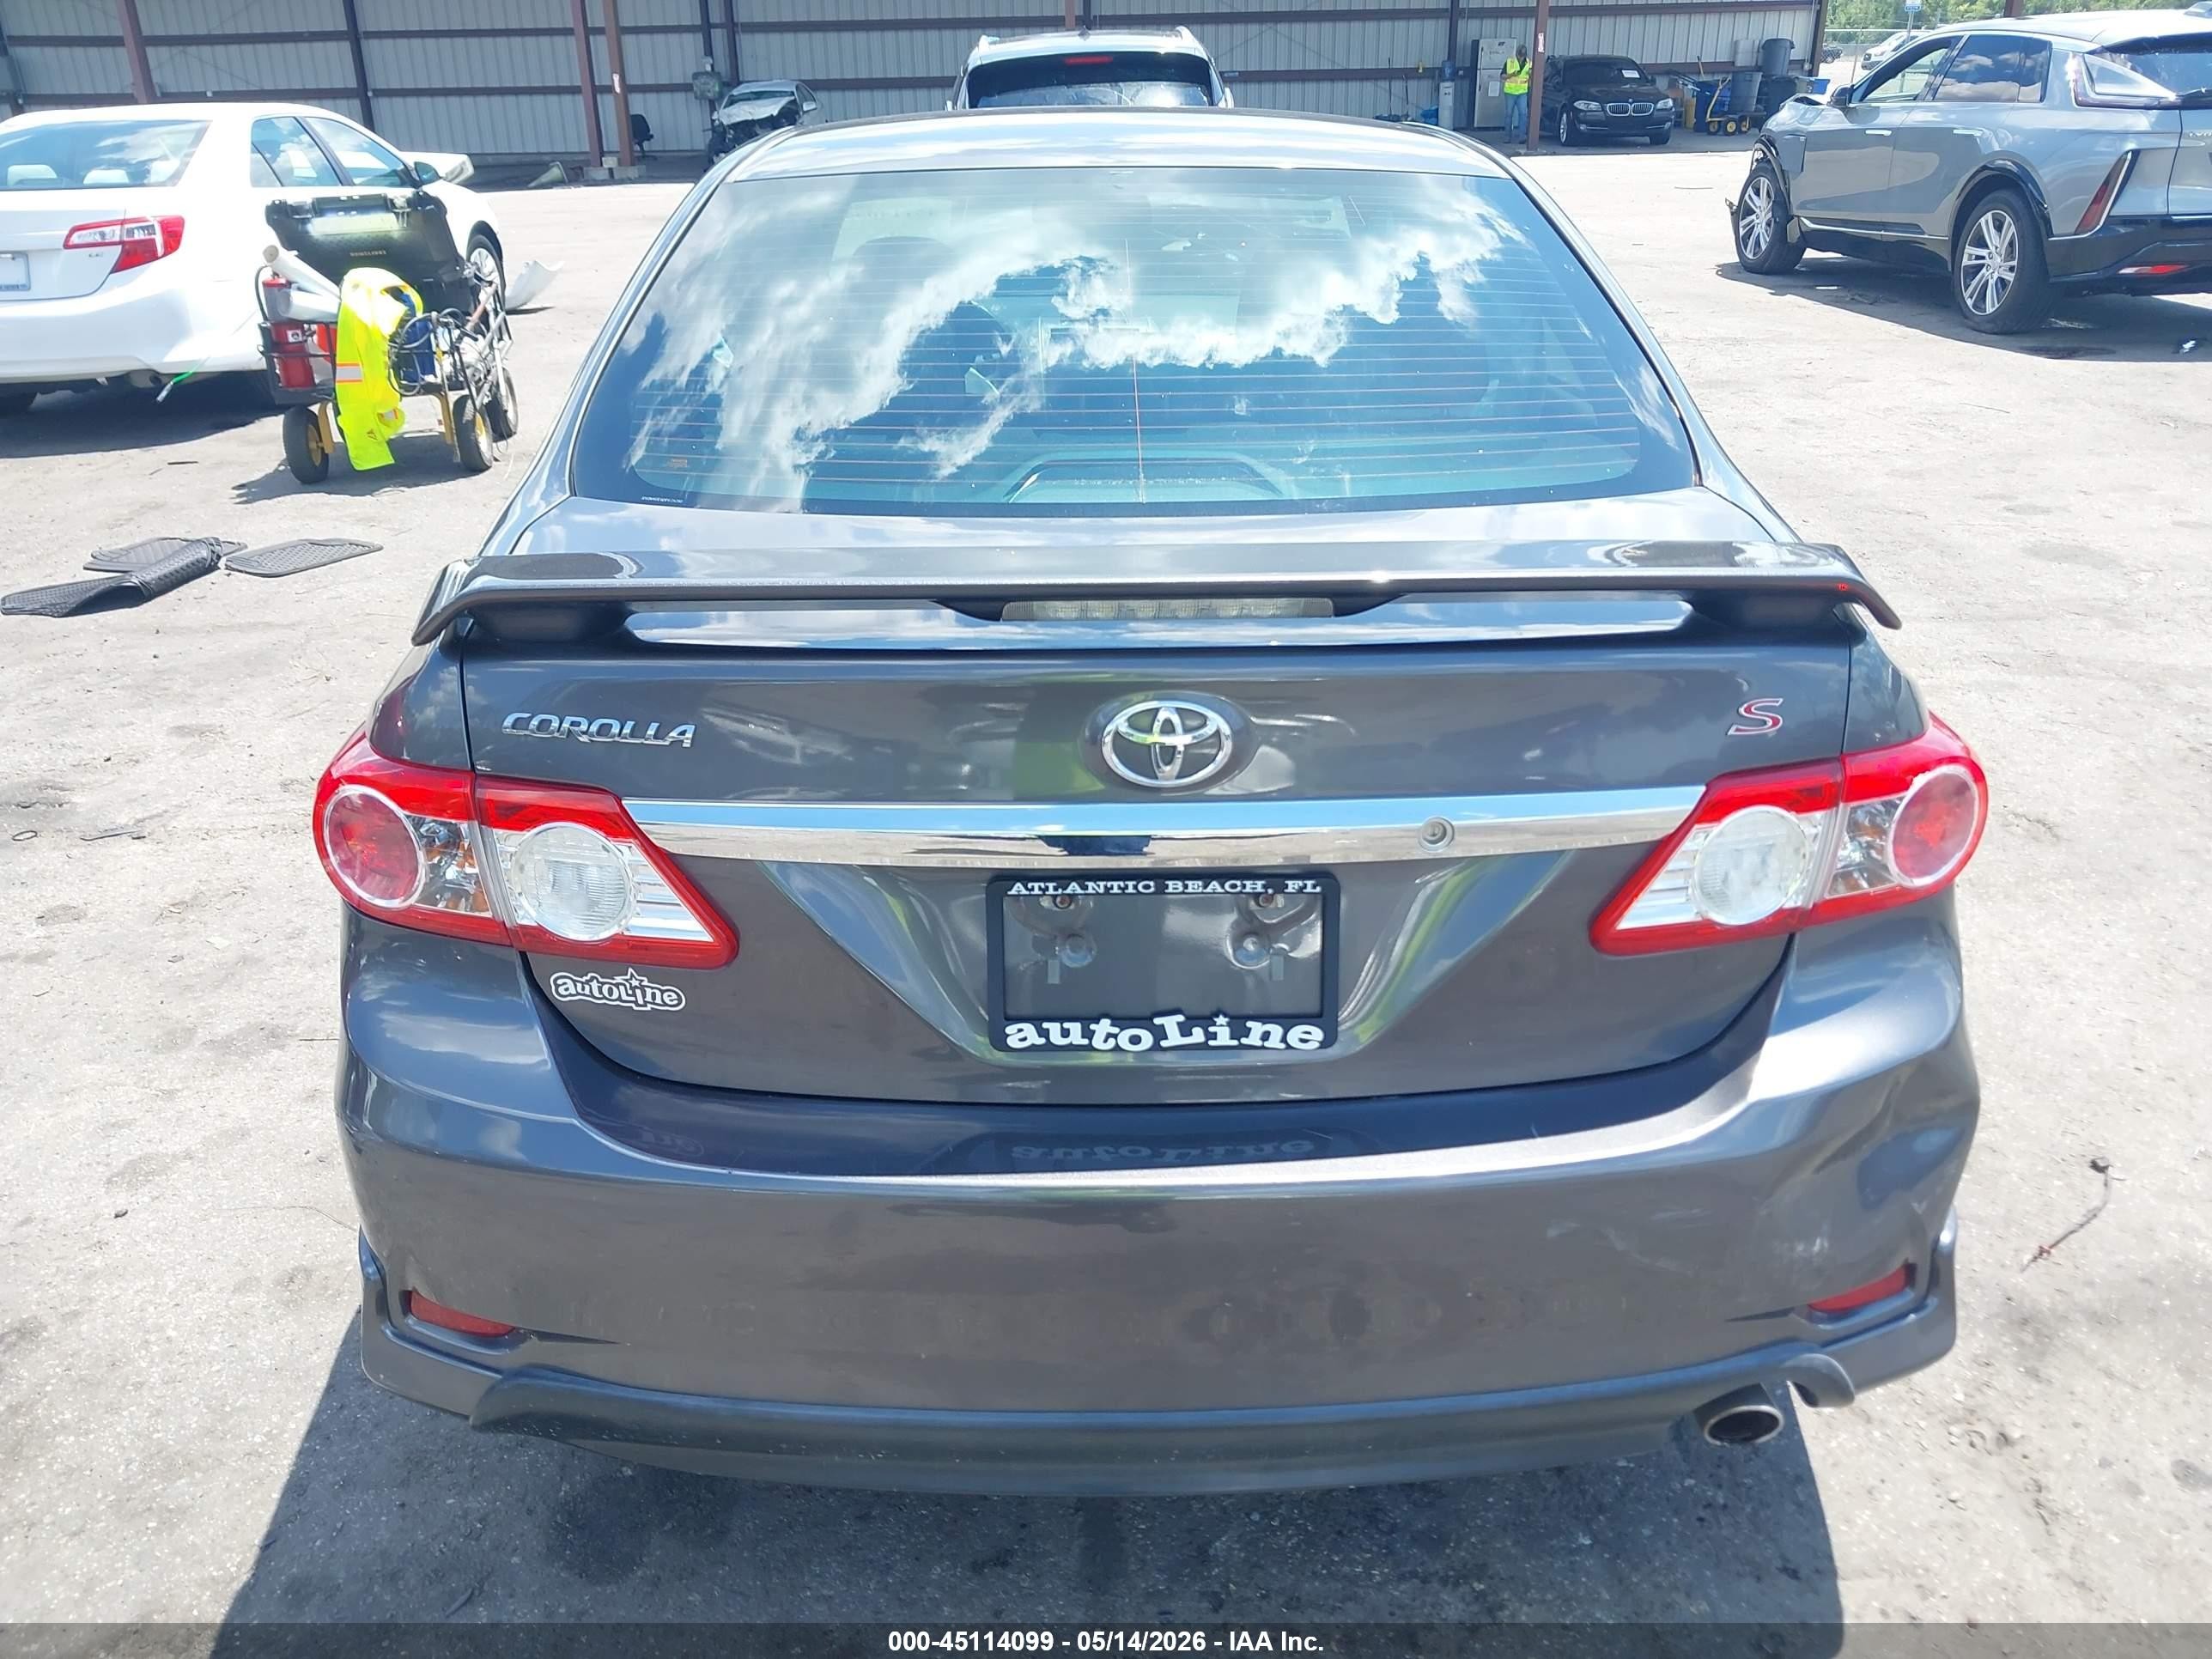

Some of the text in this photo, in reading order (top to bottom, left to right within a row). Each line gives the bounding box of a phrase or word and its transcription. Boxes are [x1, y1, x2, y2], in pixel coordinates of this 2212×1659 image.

[501, 712, 696, 748] COROLLA
[1727, 697, 1784, 736] S
[1006, 879, 1322, 895] ATLANTIC BEACH, FL
[554, 975, 681, 1006] autoLine
[1004, 1013, 1325, 1052] autoLine
